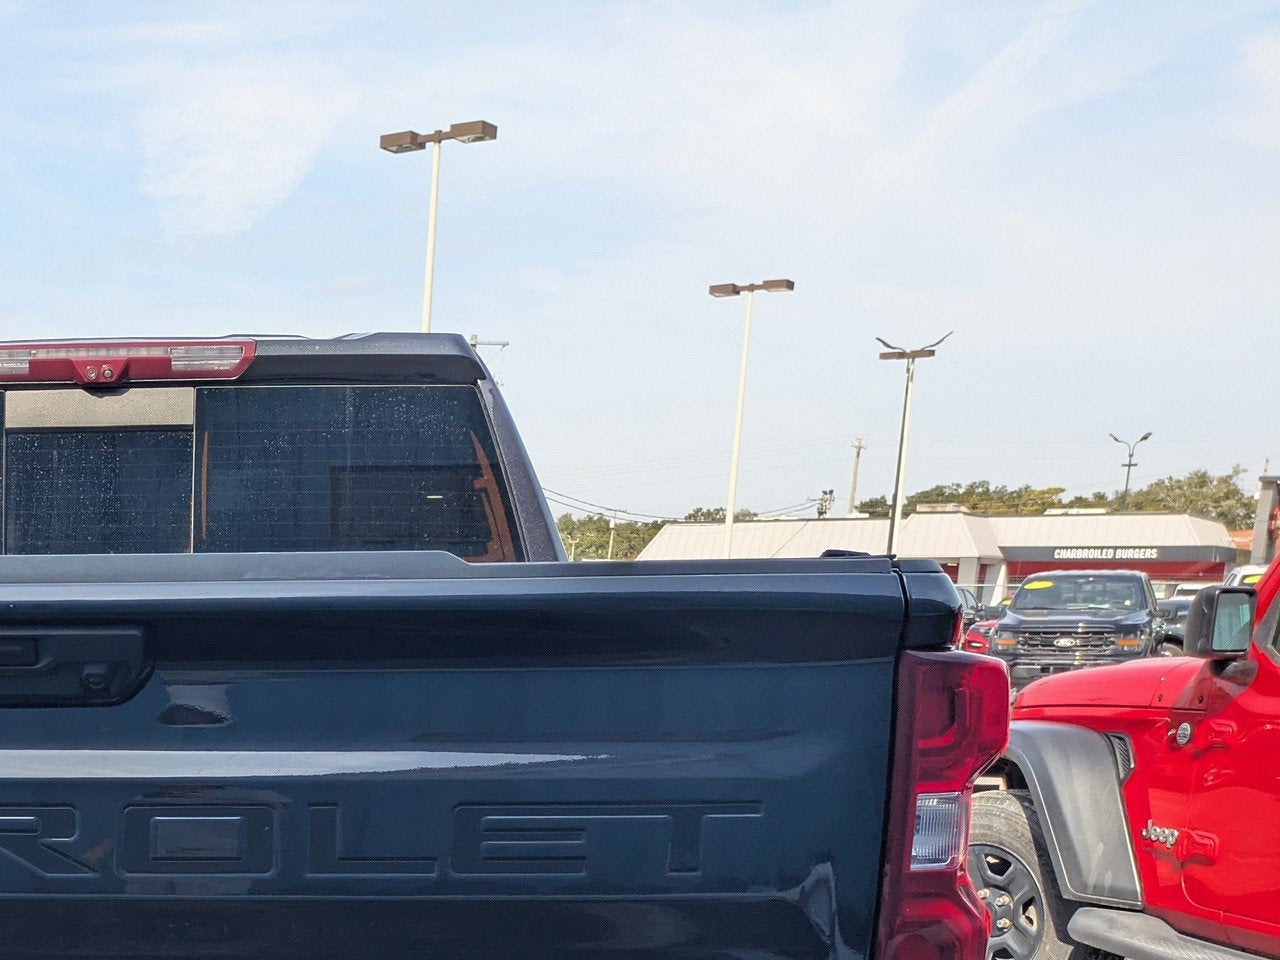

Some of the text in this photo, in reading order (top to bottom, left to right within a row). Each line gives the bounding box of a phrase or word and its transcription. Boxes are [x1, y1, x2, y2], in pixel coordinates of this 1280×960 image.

[1053, 548, 1158, 559] CHARBROILED BURGERS
[1141, 819, 1179, 849] Jeep
